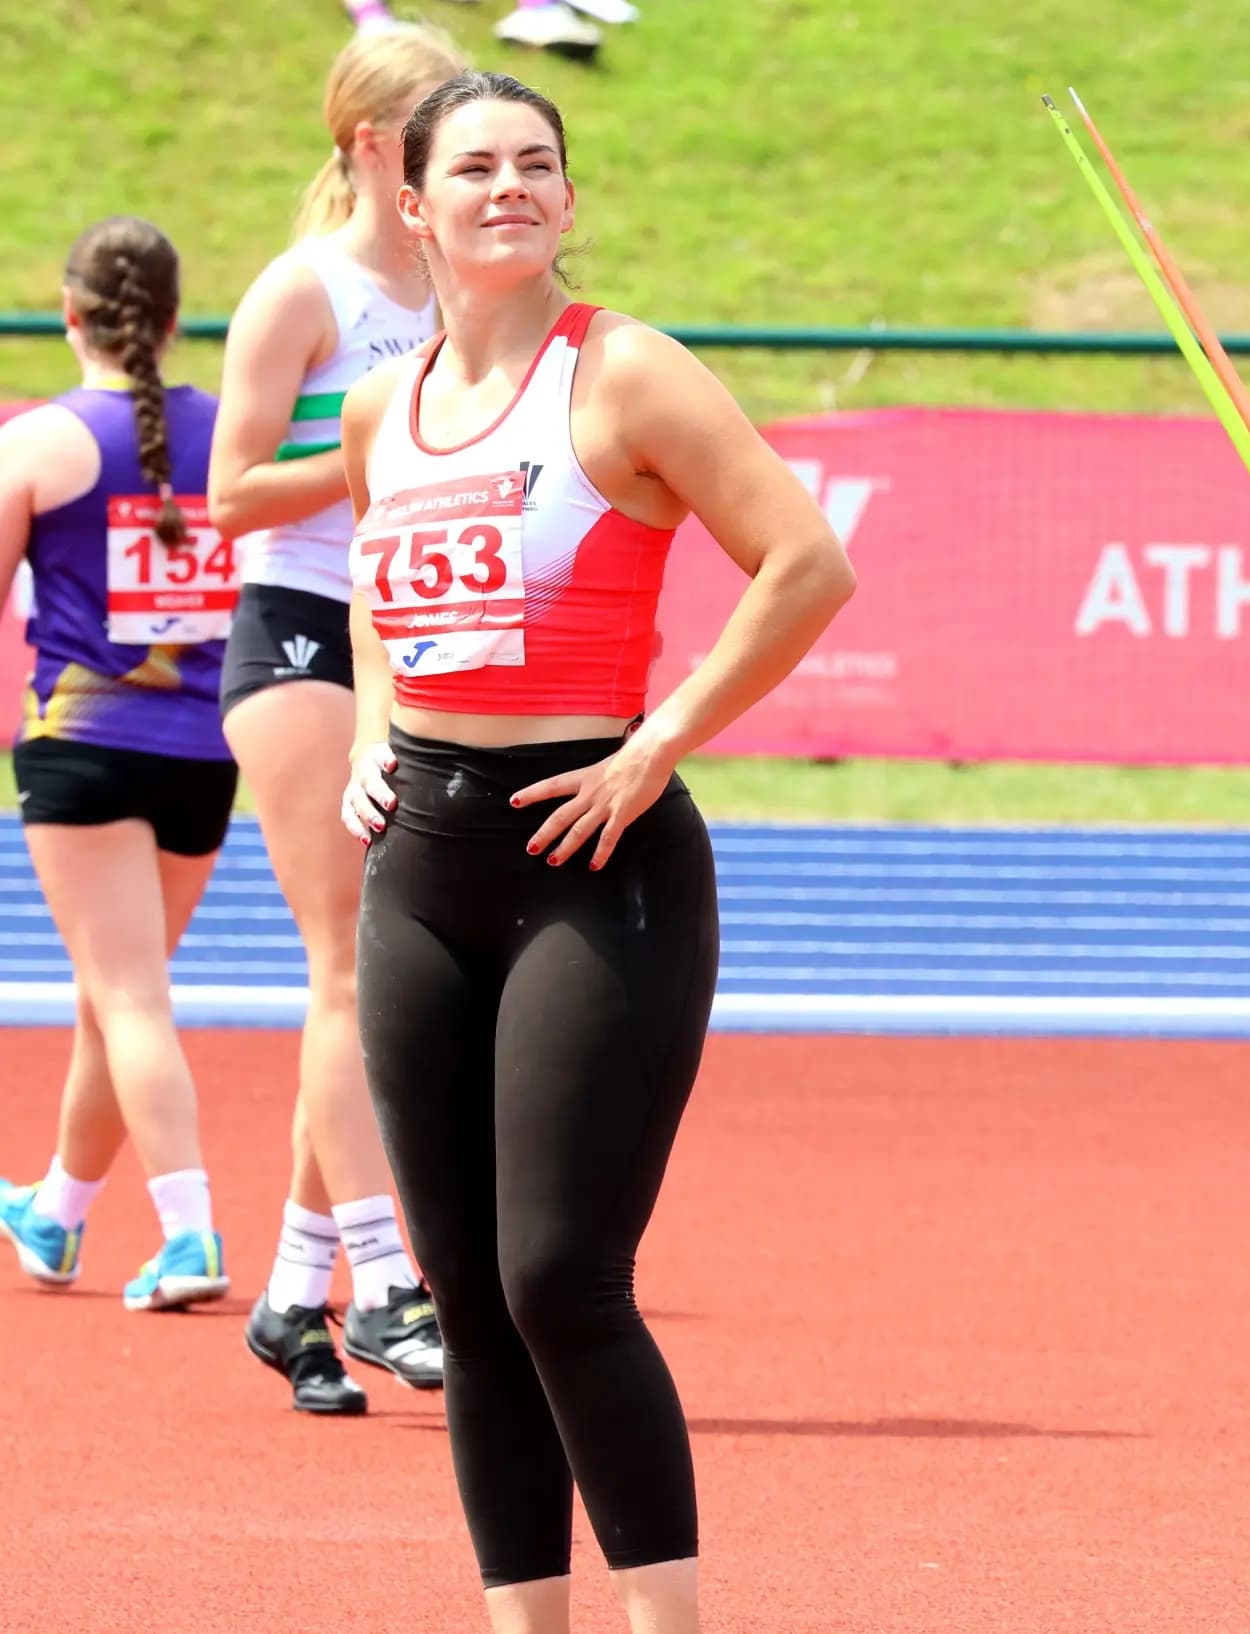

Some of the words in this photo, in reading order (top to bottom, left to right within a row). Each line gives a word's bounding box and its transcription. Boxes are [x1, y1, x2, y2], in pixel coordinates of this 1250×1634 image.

[422, 490, 490, 513] ATHLETICS
[125, 534, 236, 585] 154
[360, 523, 507, 602] 753
[407, 610, 460, 629] JONES
